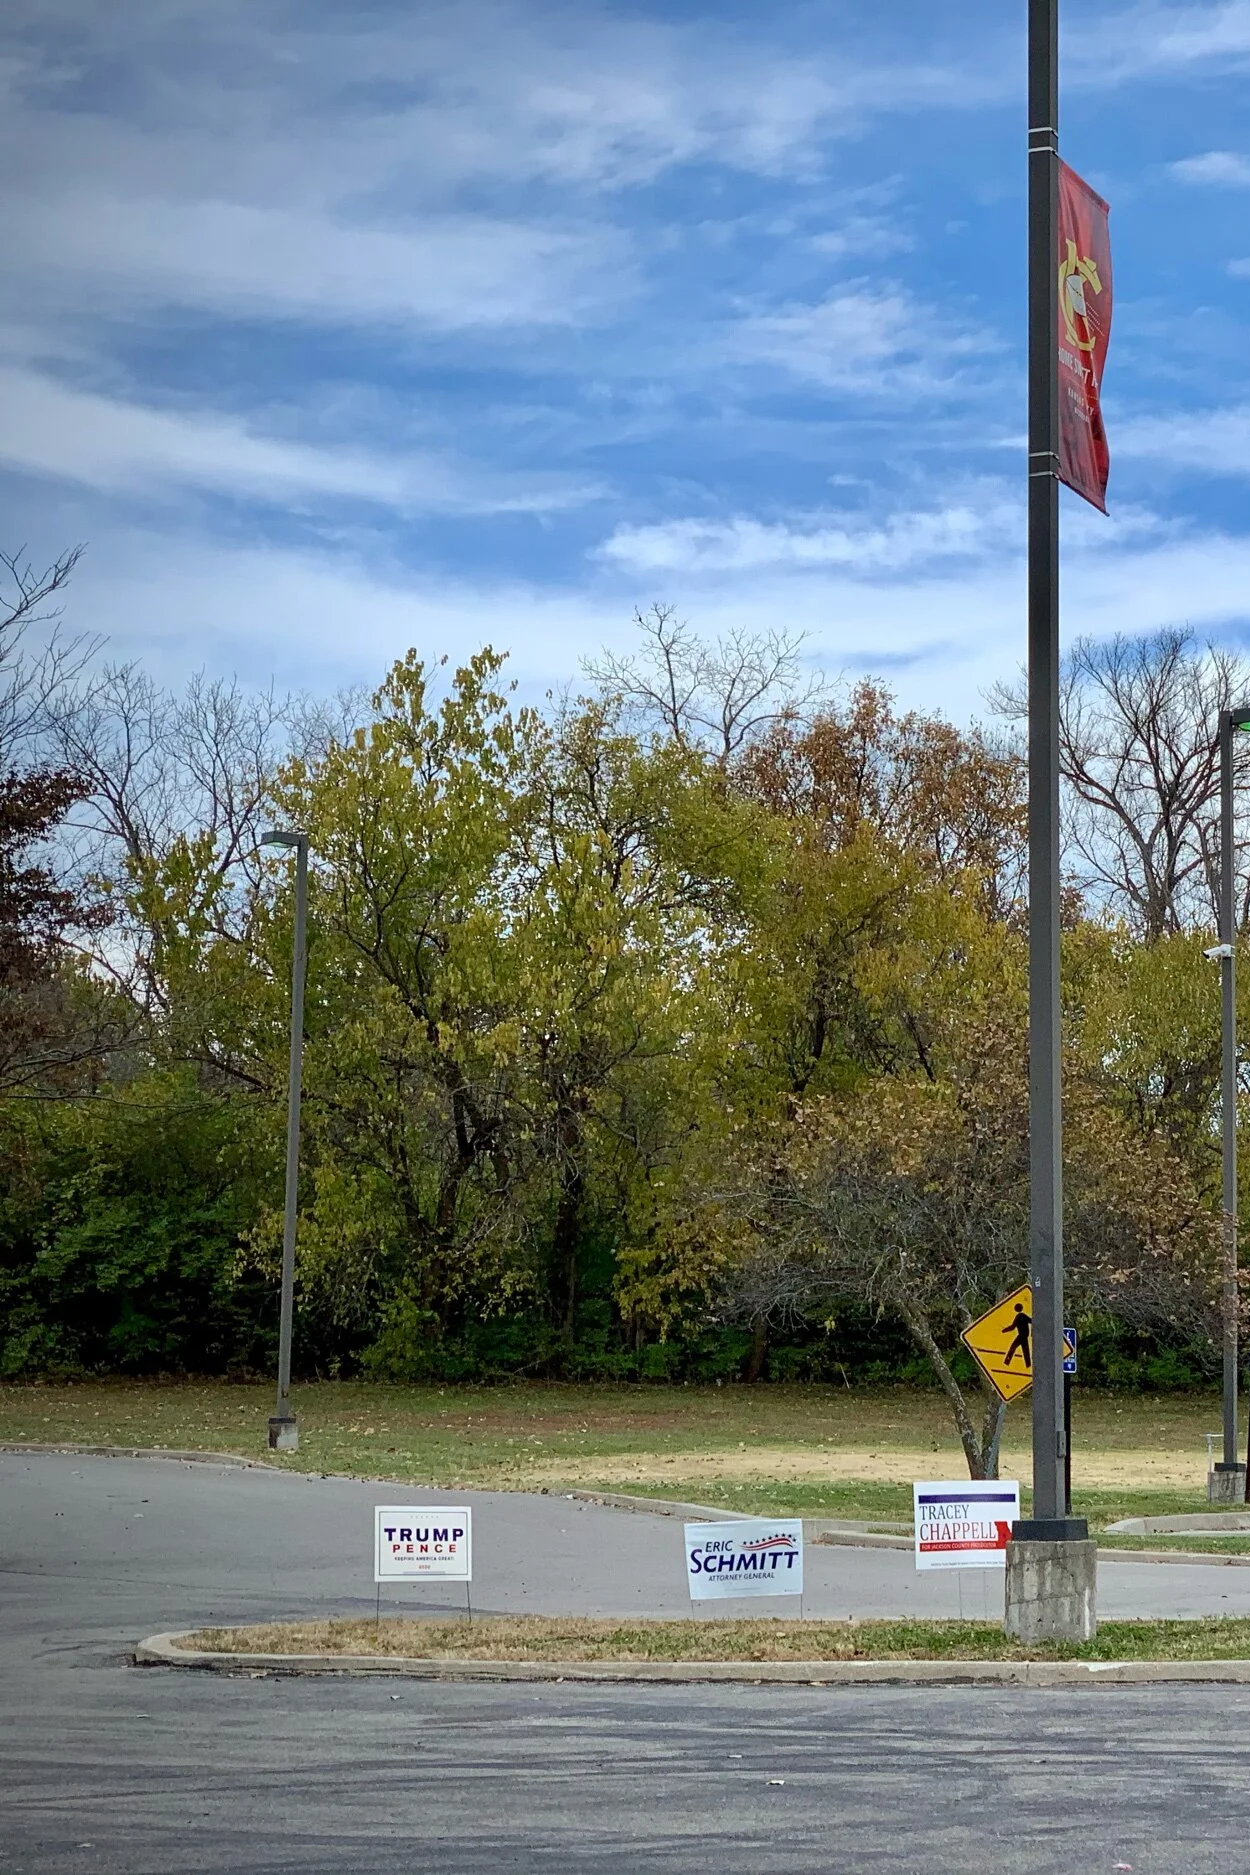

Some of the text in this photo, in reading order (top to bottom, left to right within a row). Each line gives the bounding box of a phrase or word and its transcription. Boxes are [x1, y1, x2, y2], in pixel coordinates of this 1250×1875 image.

[919, 1504, 969, 1520] TRACEY
[384, 1528, 464, 1542] TRUMP
[920, 1521, 996, 1541] CHAPPELL
[392, 1544, 457, 1553] PENCE
[705, 1540, 733, 1553] ERIC
[690, 1549, 799, 1574] SCHMITT
[709, 1572, 775, 1582] ATTORNEY GENERAL
